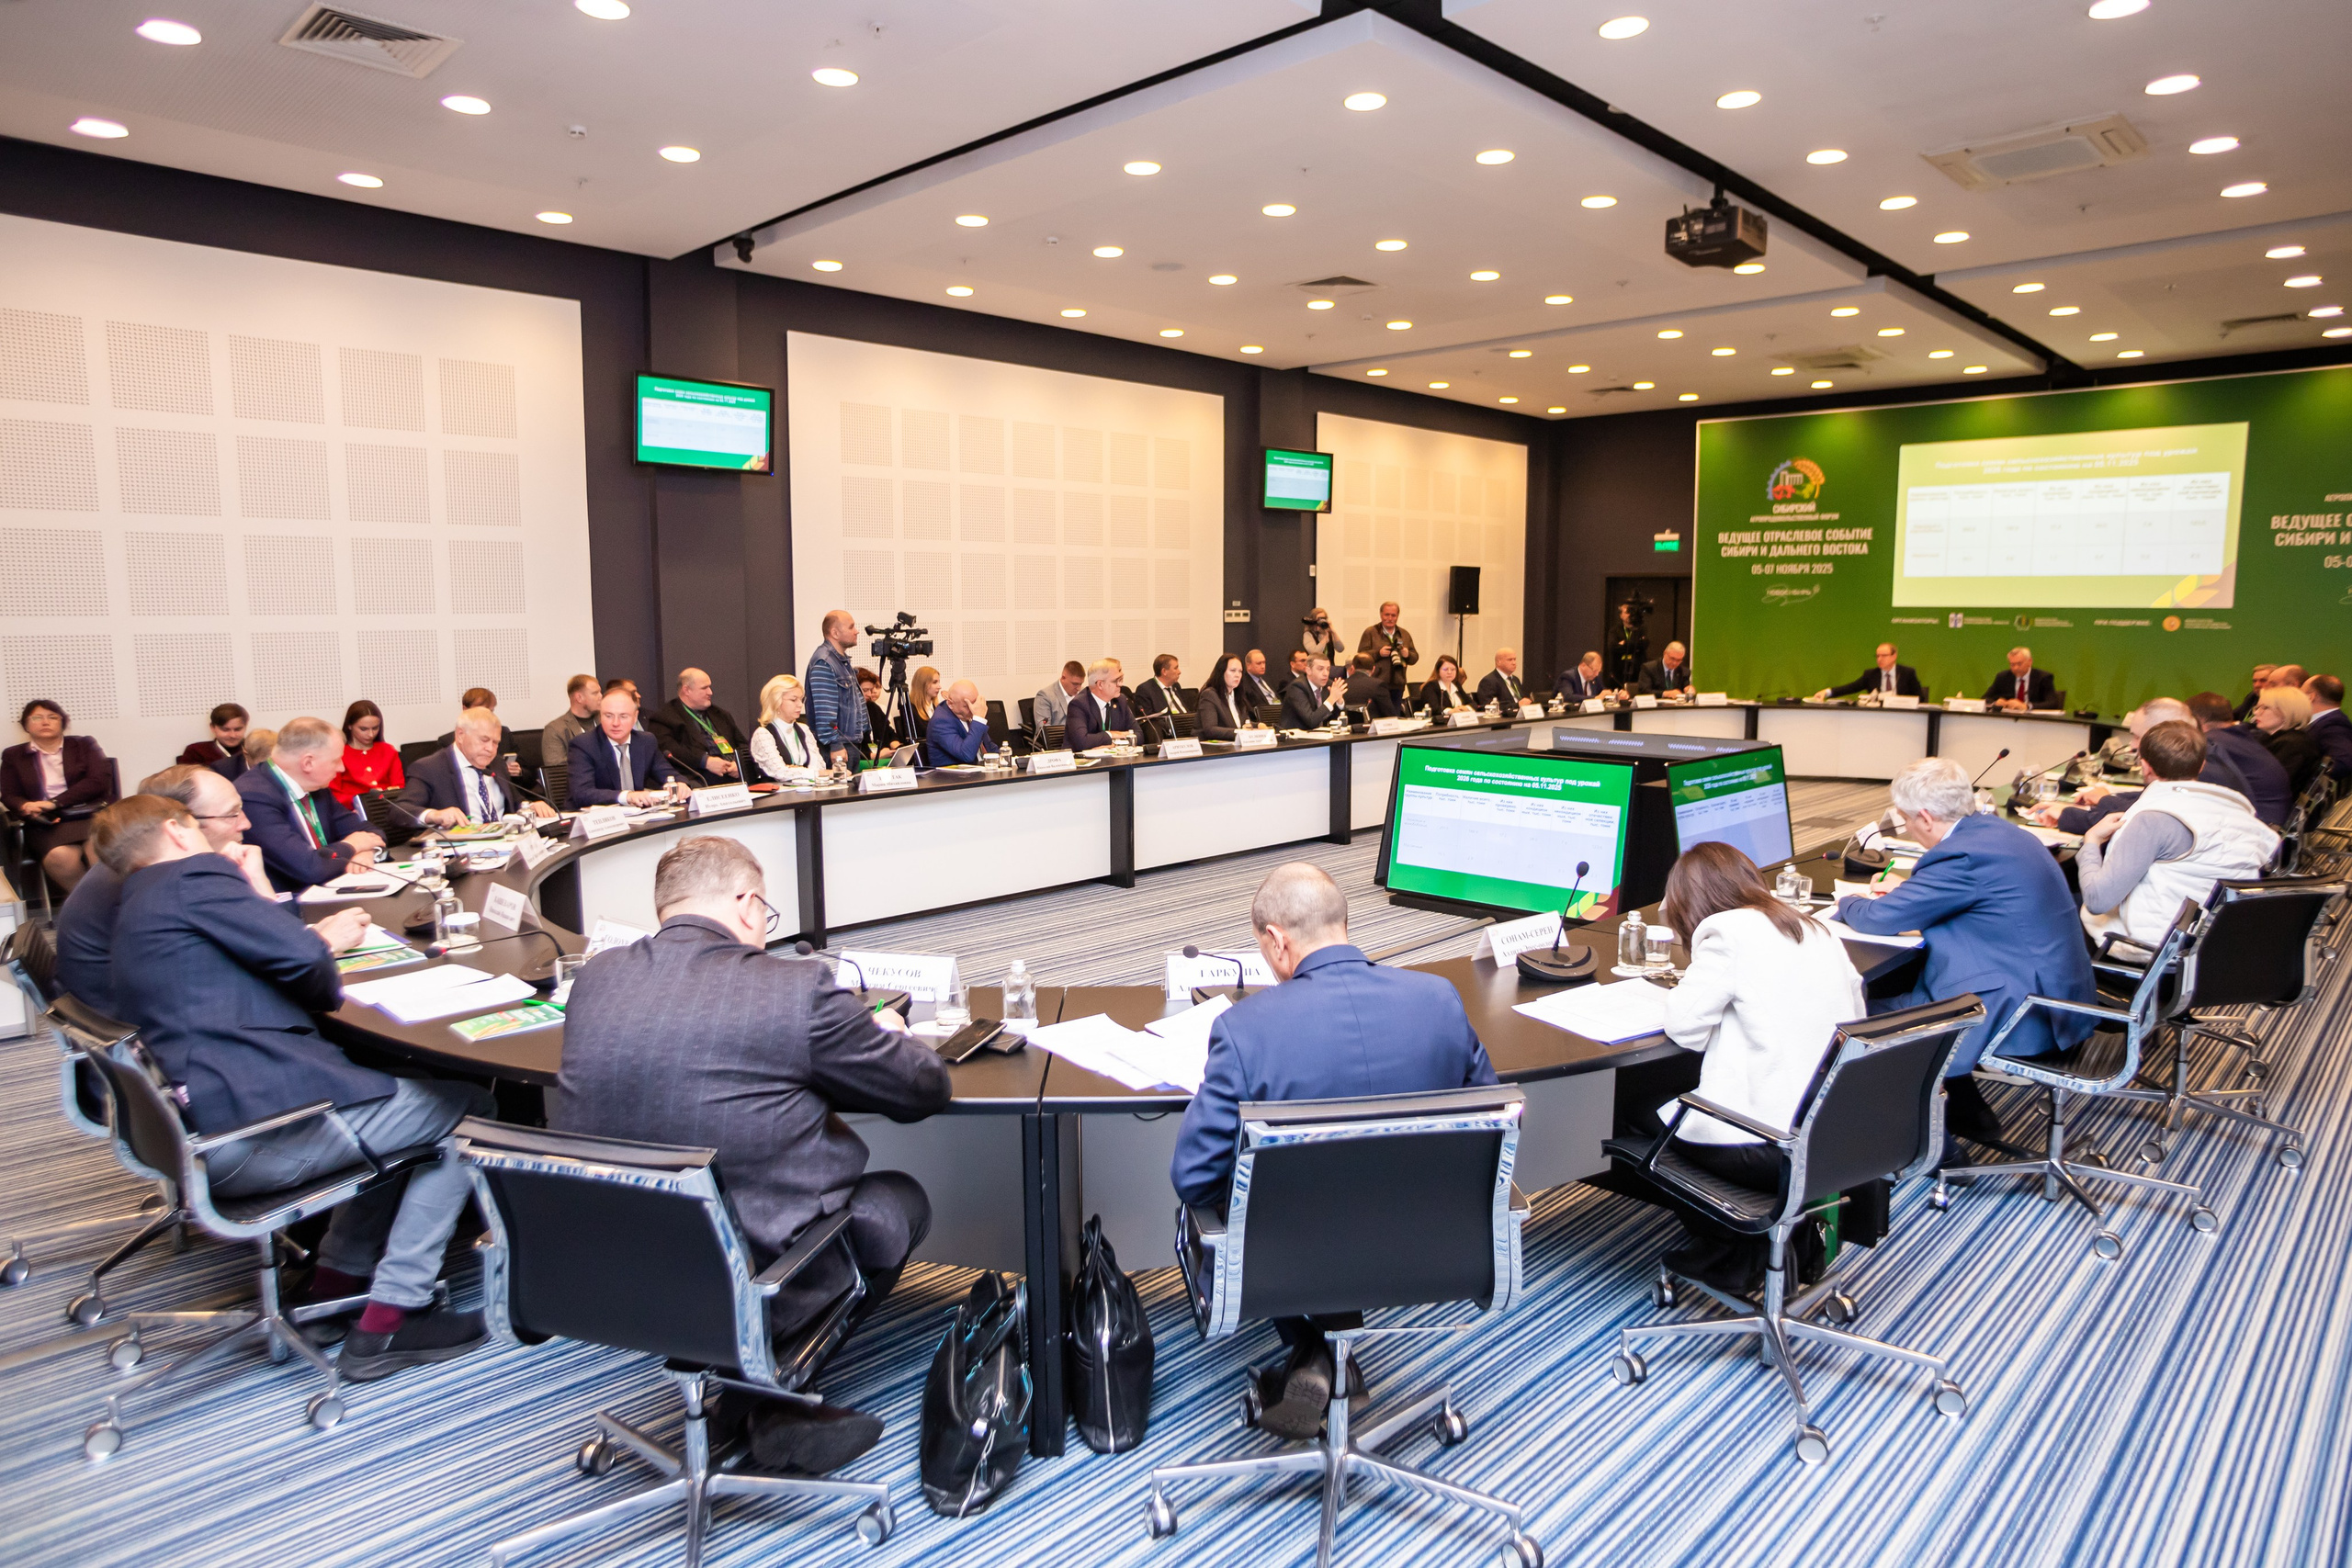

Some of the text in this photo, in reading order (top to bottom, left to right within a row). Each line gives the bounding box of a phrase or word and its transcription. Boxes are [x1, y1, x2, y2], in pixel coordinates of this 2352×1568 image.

[1772, 502, 1815, 514] СИБИРСКИЙ
[2270, 513, 2343, 531] ВЕДУЩЕЕ
[1718, 527, 1873, 544] ВЕДУЩЕЕ ОТРАСЛЕВОЕ СОБЫТИЕ
[2274, 531, 2351, 547] СИБИРИ И
[1721, 542, 1869, 558] СИБИРИ И ДАЛЬНЕГО ВОСТОКА
[1751, 562, 1834, 575] 05-07 НОЯБРЯ 2025
[1425, 764, 1455, 774] Подготовка
[1474, 771, 1539, 782] сельскохозяйственных
[1540, 776, 1565, 784] культур
[1491, 779, 1523, 787] состоянию
[1532, 782, 1562, 791] 05.11.2025
[868, 966, 922, 978] ЧЕКУСОВ
